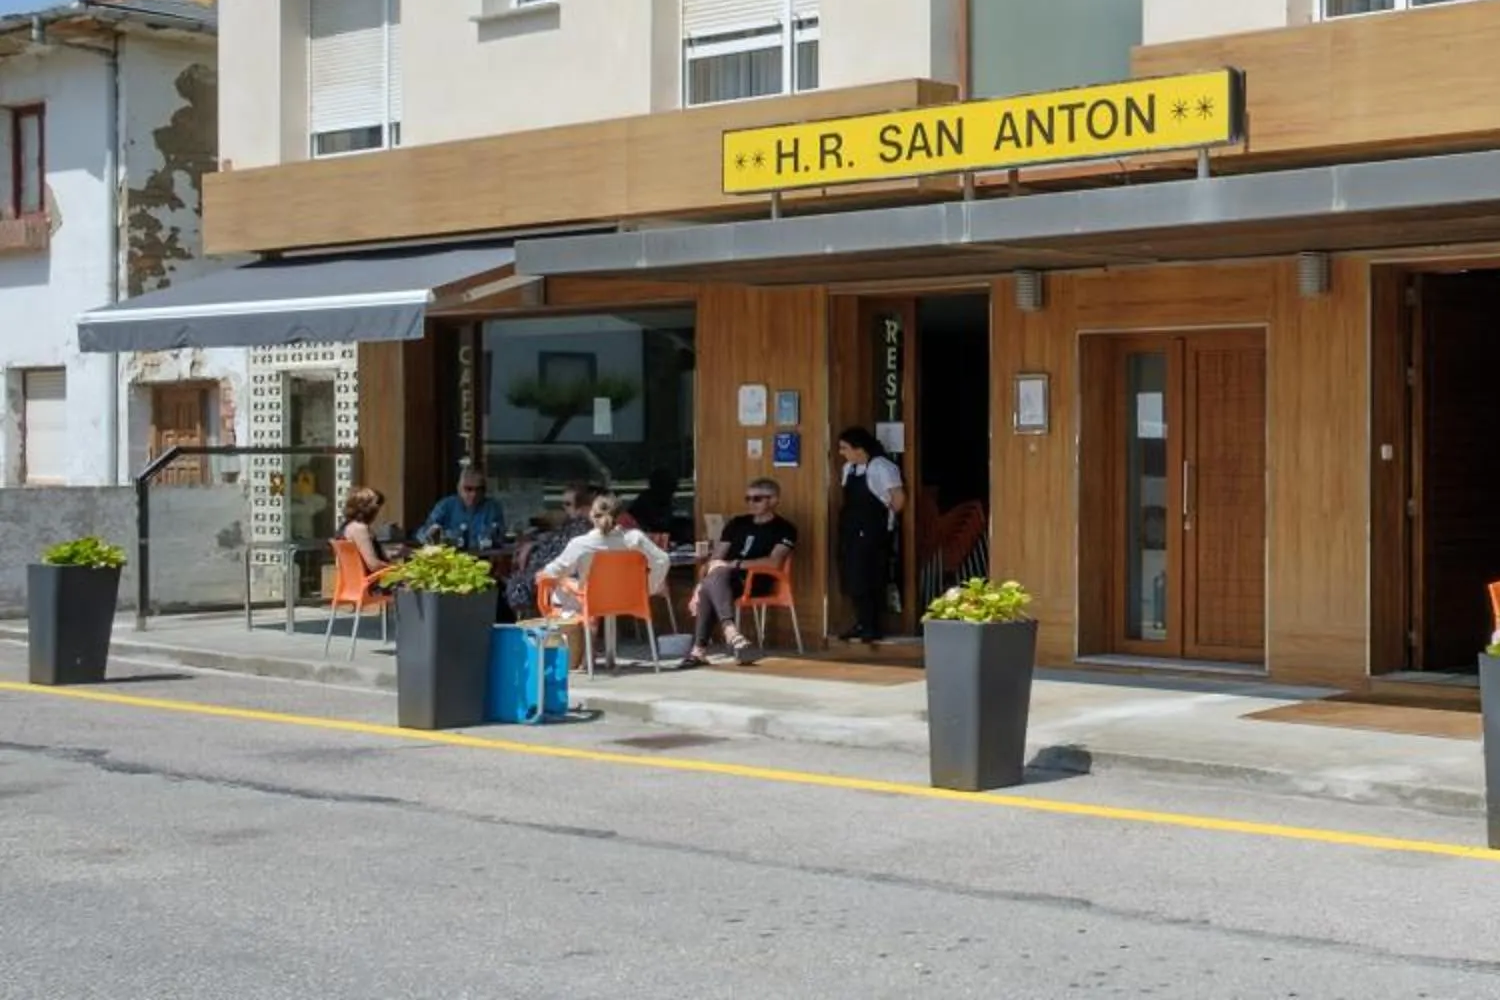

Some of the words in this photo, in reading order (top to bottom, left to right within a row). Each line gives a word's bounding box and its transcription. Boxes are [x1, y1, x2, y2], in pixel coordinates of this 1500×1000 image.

[775, 133, 854, 175] H.R.
[878, 117, 965, 164] SAN
[993, 93, 1157, 152] ANTON
